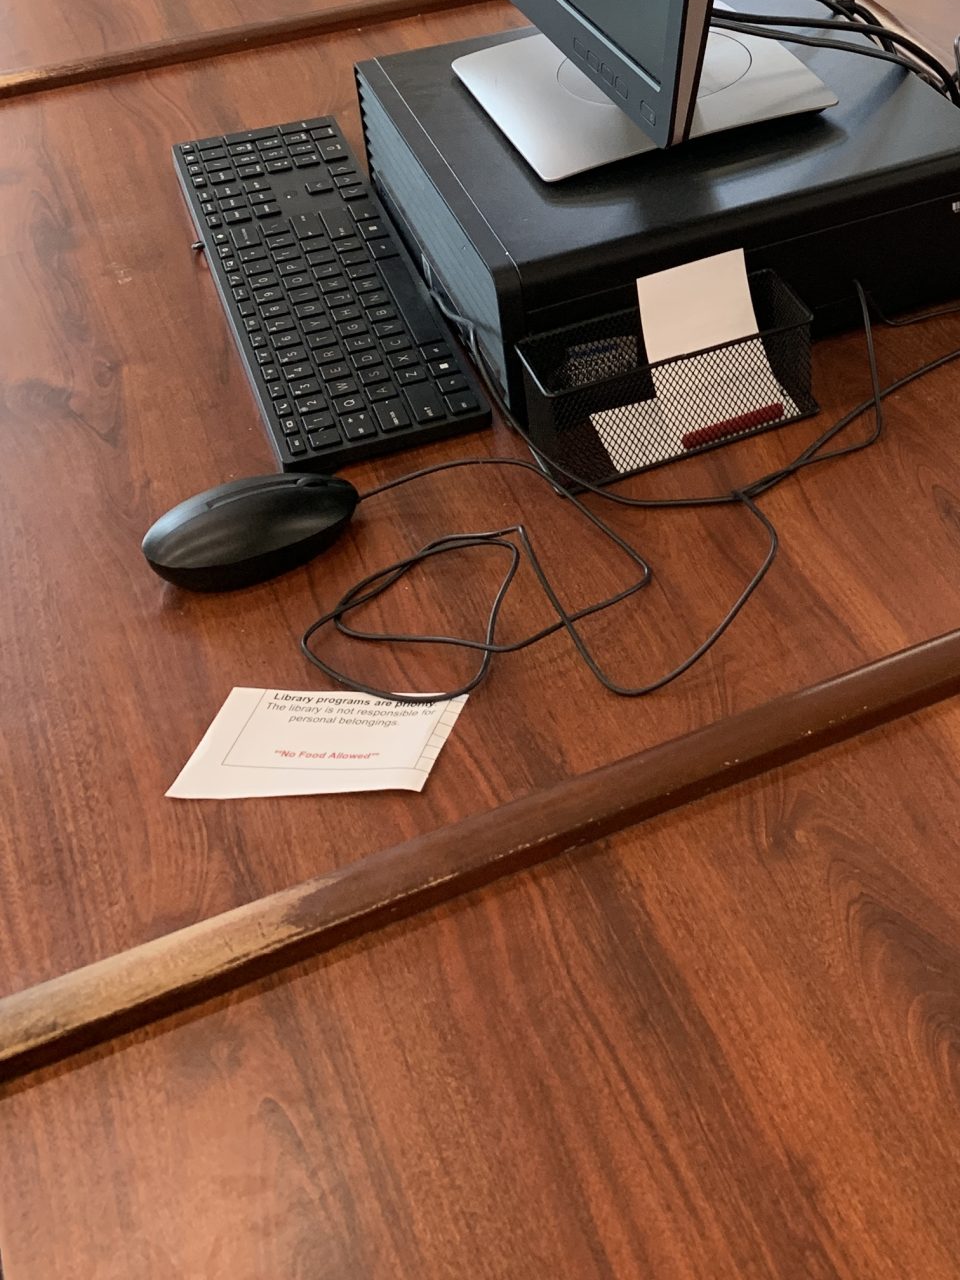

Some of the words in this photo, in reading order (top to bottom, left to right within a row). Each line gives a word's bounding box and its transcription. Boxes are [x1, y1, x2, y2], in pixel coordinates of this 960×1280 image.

[273, 693, 315, 704] Library
[316, 697, 370, 705] programs
[266, 702, 287, 711] The
[289, 704, 322, 714] library
[325, 706, 334, 714] is
[357, 708, 418, 718] responsible
[288, 715, 337, 724] personal
[299, 751, 327, 759] Food
